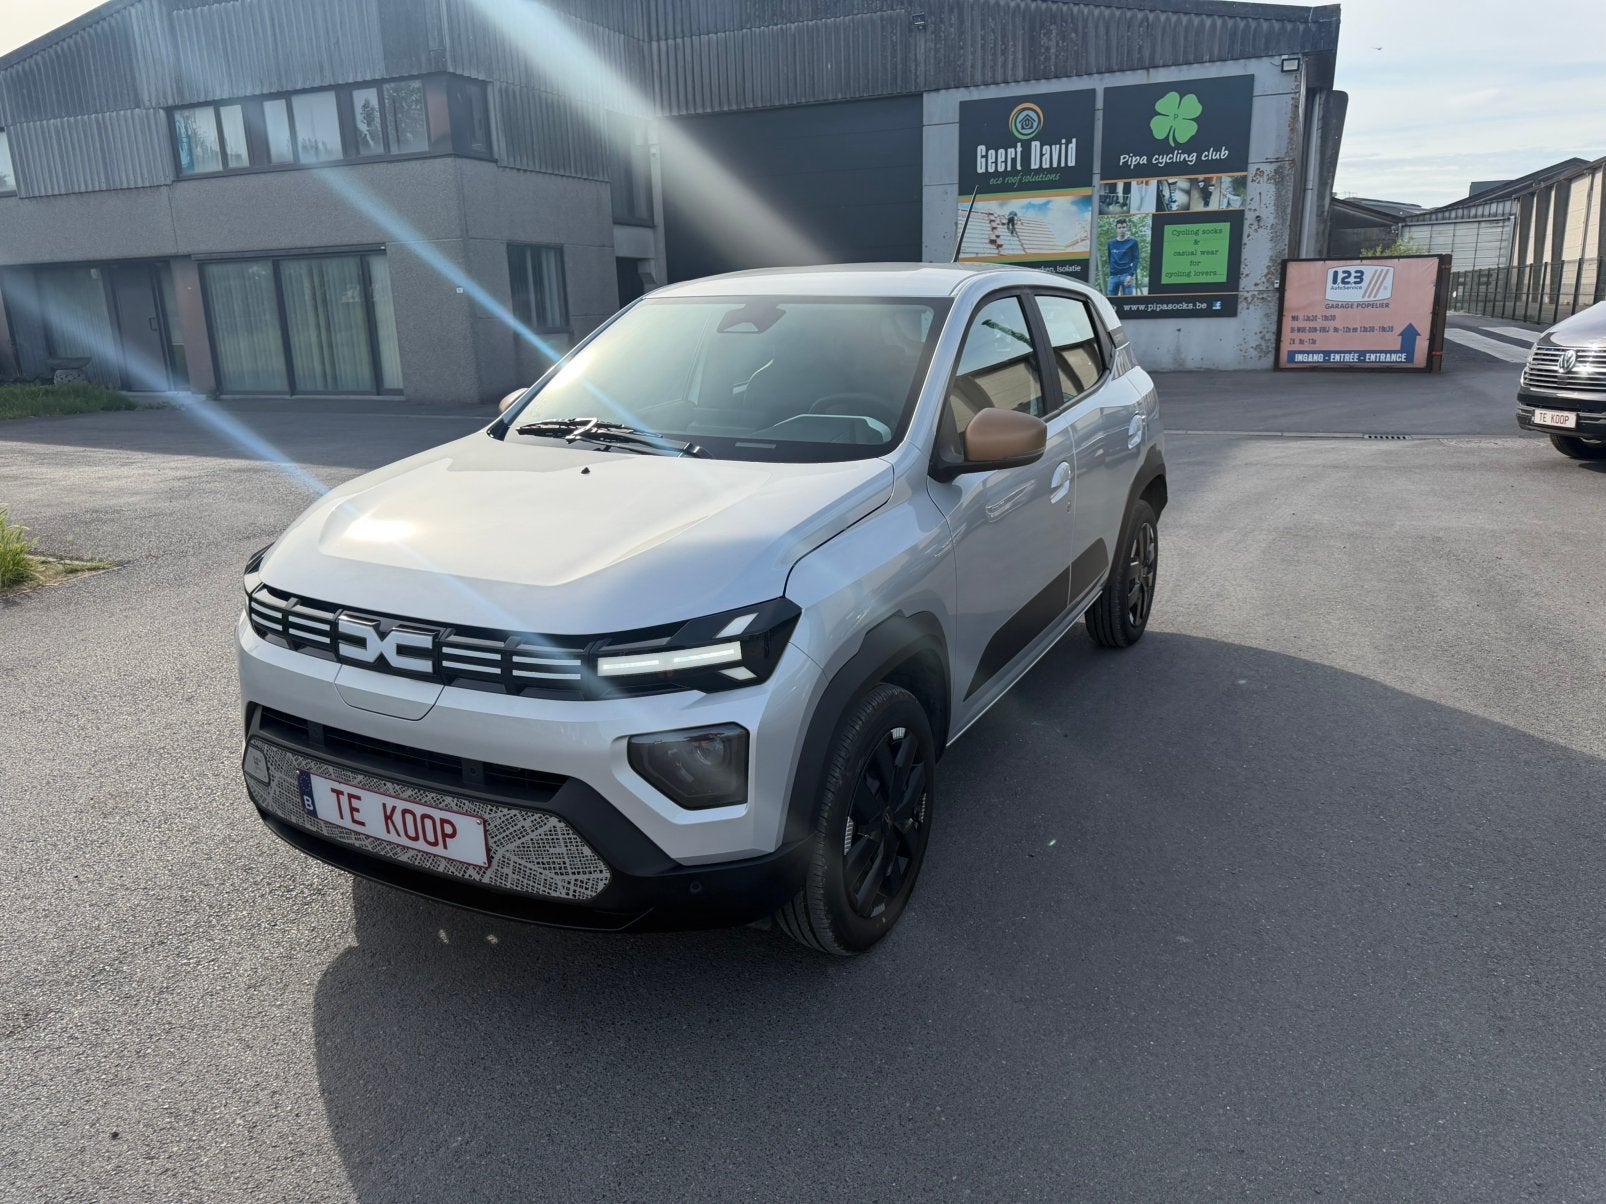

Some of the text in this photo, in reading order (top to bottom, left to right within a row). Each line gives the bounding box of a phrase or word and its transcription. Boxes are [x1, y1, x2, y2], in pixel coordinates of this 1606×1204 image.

[976, 138, 1076, 174] Geert David
[1120, 146, 1229, 169] Pipa cycling club
[1004, 173, 1022, 188] roof
[1022, 172, 1060, 182] solutions
[1172, 228, 1200, 237] Cycling
[1123, 301, 1208, 312] www.pipasocks.be
[1295, 353, 1324, 362] INGANG
[1330, 352, 1359, 362] ENTRÉE
[1366, 353, 1407, 362] ENTRANCE
[1539, 412, 1569, 424] TE KOOP
[303, 787, 457, 850] B TE KOOP
